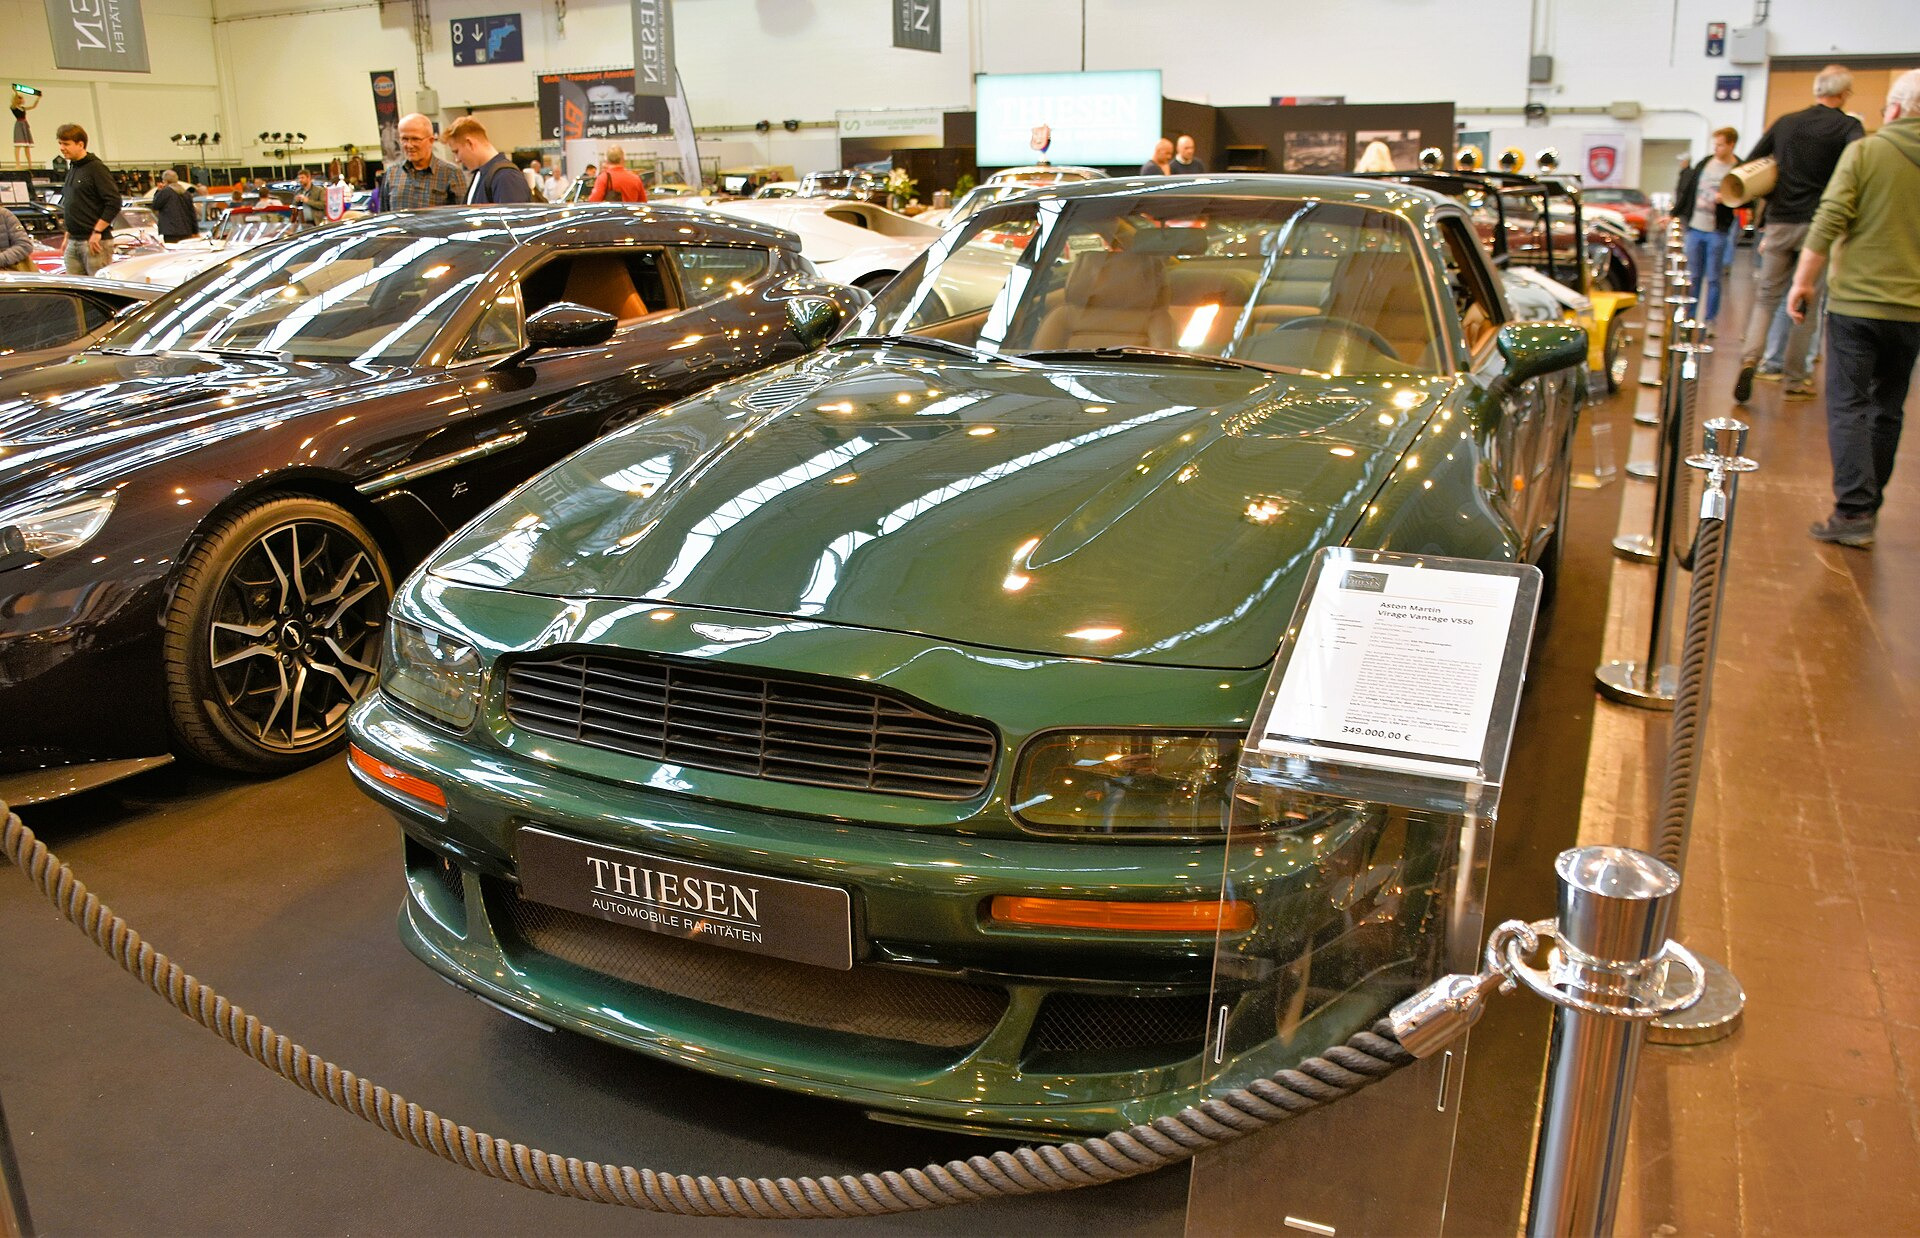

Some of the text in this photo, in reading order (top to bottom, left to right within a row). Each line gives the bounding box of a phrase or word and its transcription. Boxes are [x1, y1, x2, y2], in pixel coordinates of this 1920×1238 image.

[453, 23, 463, 44] 8
[543, 74, 566, 83] Globl
[567, 72, 602, 82] Transport
[1380, 602, 1441, 613] Aston Martin
[1378, 610, 1408, 619] Virage
[1410, 613, 1448, 623] Vantage
[1342, 725, 1402, 740] 349.000,00
[586, 856, 760, 922] THIESEN
[592, 898, 763, 944] AUTOMOBILE RARITÄTEN
